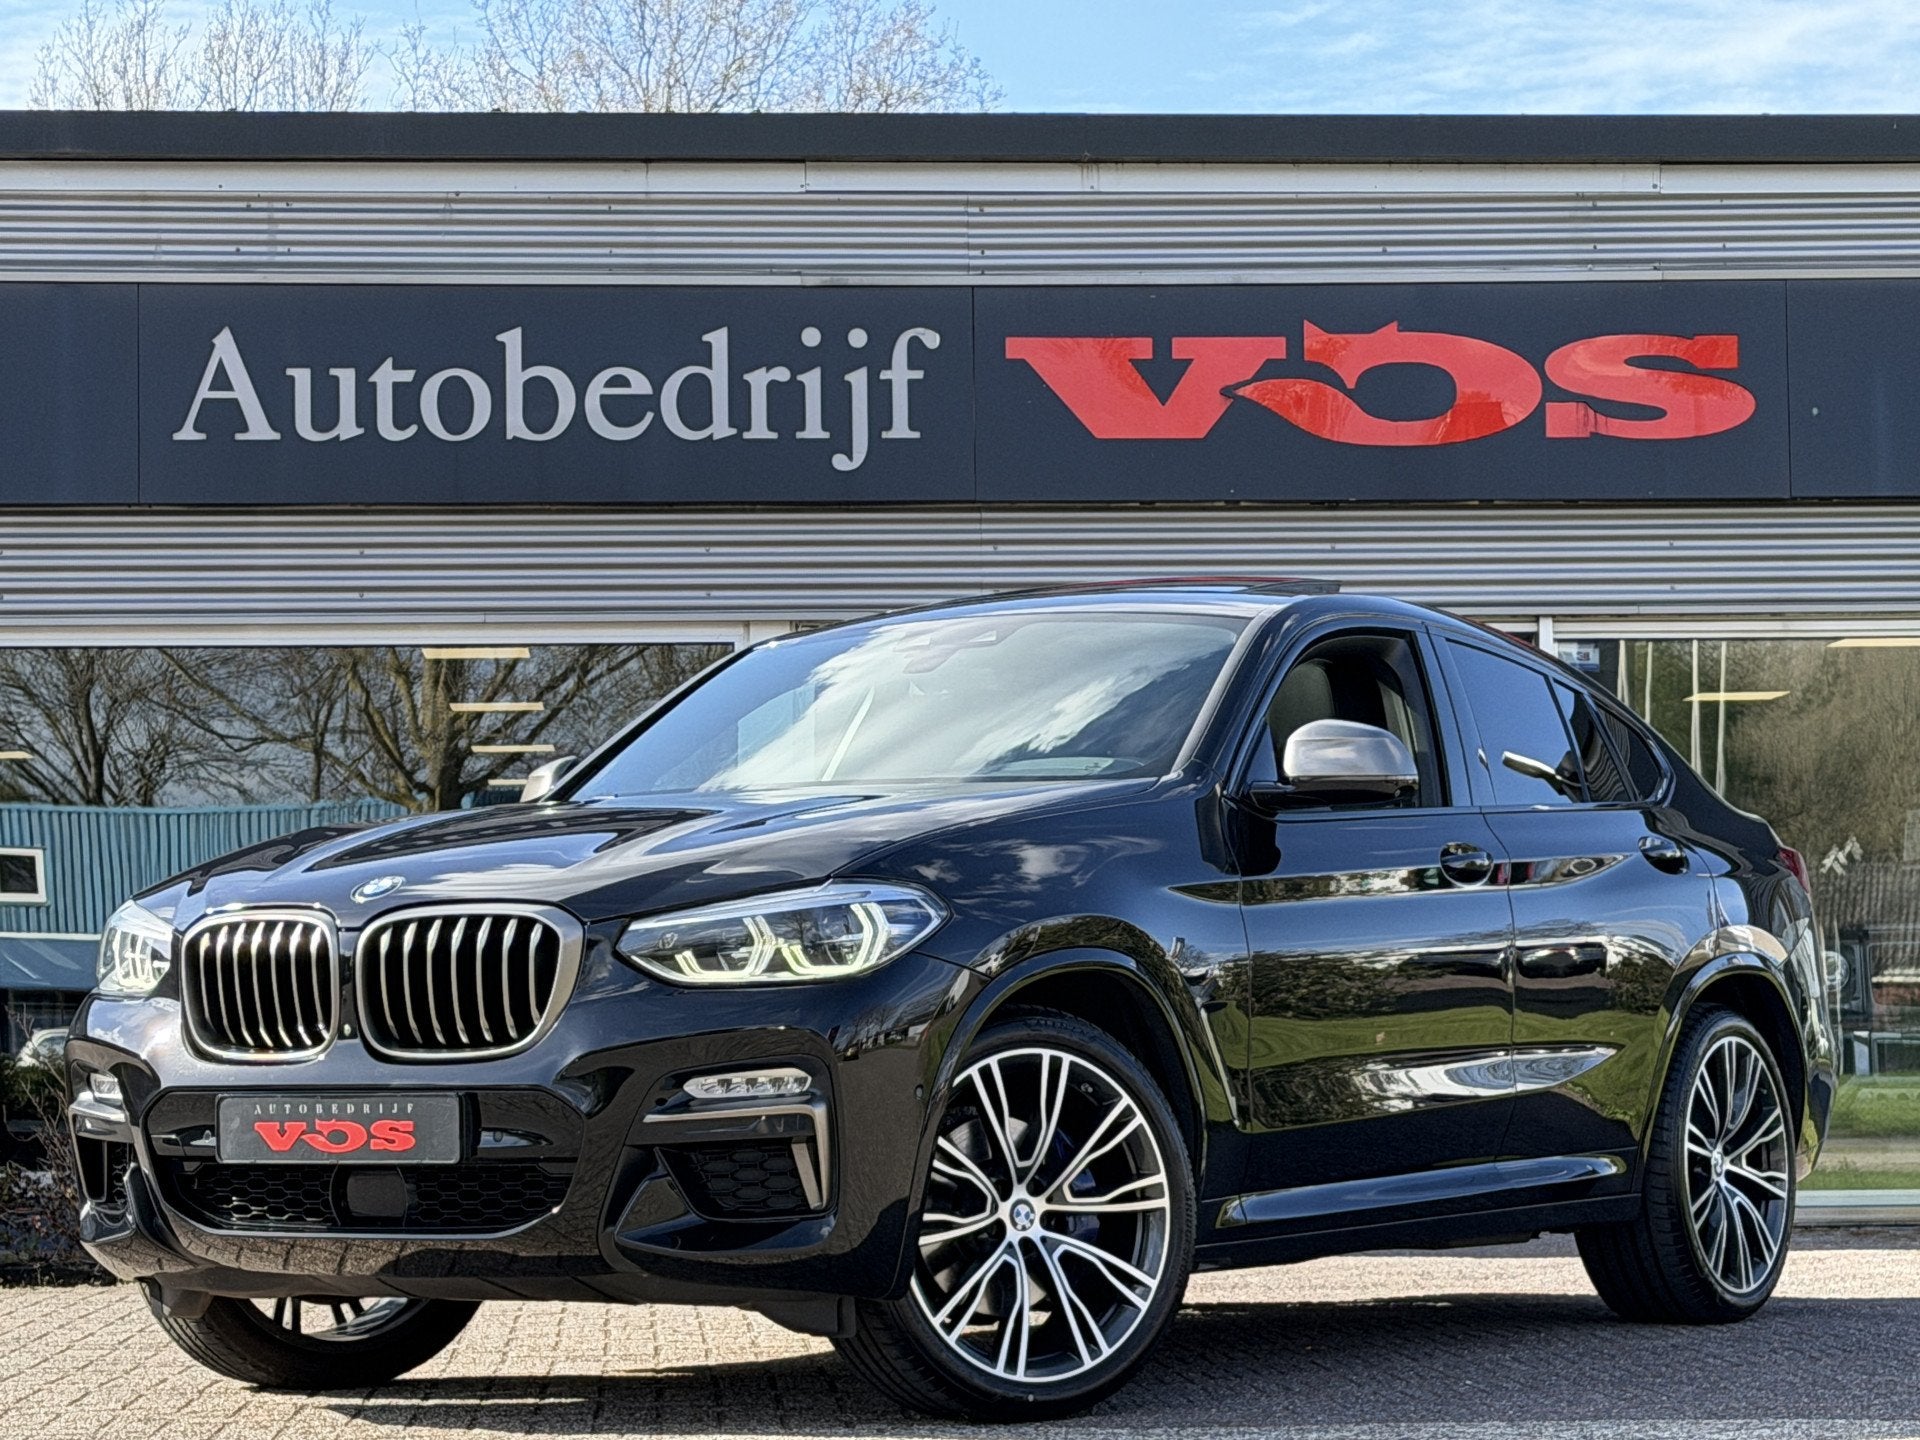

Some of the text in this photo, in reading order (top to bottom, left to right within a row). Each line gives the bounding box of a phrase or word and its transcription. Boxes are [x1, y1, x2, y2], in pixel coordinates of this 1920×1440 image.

[172, 320, 1756, 471] Autobedrijf VOS
[253, 1102, 414, 1115] AUTOBEDRIJF
[253, 1119, 416, 1154] VOS
